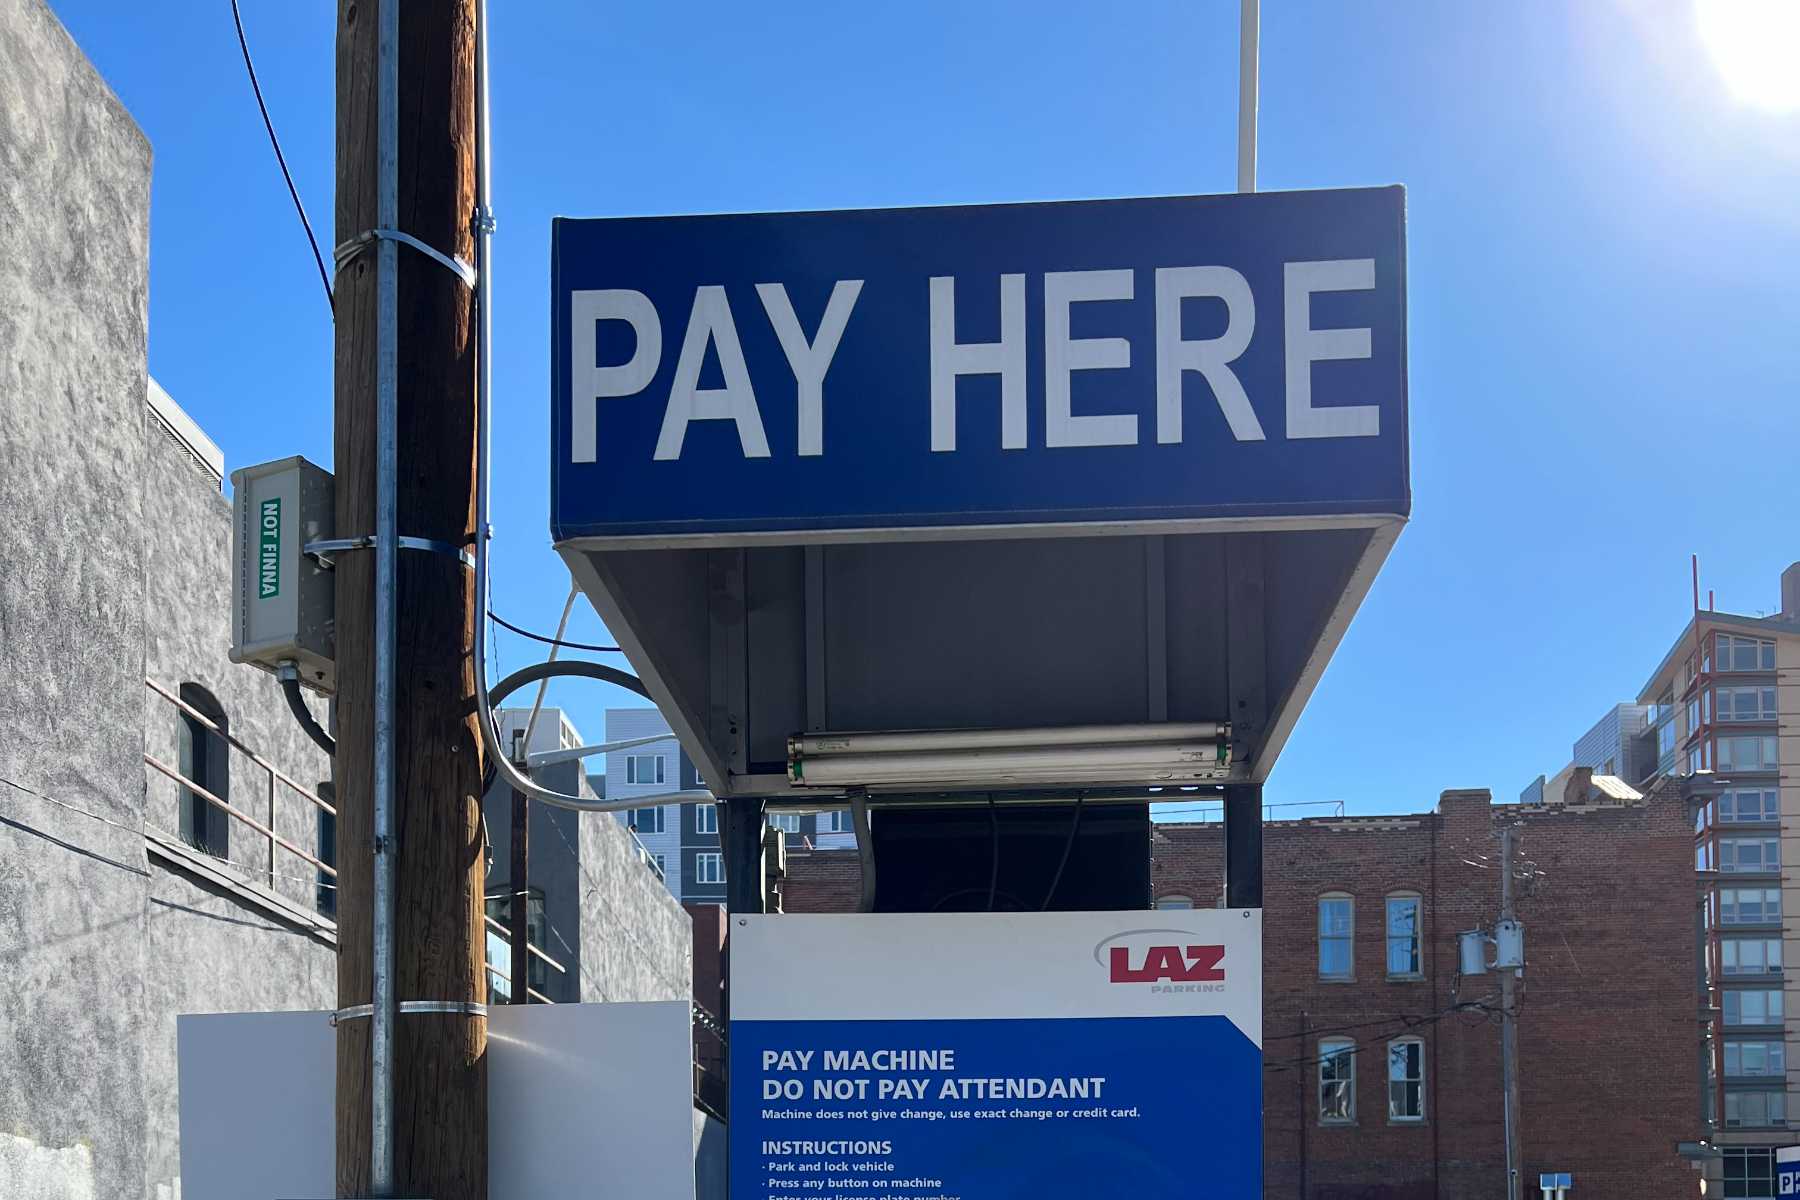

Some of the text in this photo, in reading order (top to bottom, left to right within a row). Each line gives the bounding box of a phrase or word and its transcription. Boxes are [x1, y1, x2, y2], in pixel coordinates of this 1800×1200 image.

[571, 258, 1380, 464] PAY HERE
[262, 503, 278, 595] NOT FINNA
[1110, 944, 1225, 983] LAZ
[1151, 984, 1226, 994] PARKING
[762, 1049, 954, 1071] PAY MACHINE
[763, 1077, 1105, 1100] DO NOT PAY ATTENDANT
[762, 1108, 812, 1119] Machine
[815, 1108, 844, 1119] does
[847, 1109, 868, 1118] not
[871, 1108, 896, 1121] give
[900, 1108, 945, 1120] change,
[950, 1110, 970, 1118] use
[973, 1108, 1006, 1118] exact
[1009, 1107, 1052, 1120] change
[1072, 1107, 1107, 1117] credit
[1110, 1106, 1140, 1117] card.
[762, 1140, 891, 1155] INSTRUCTIONS
[768, 1161, 894, 1171] Park and lock vehicle
[768, 1177, 941, 1190] Press any button on machine
[1782, 1176, 1791, 1192] P
